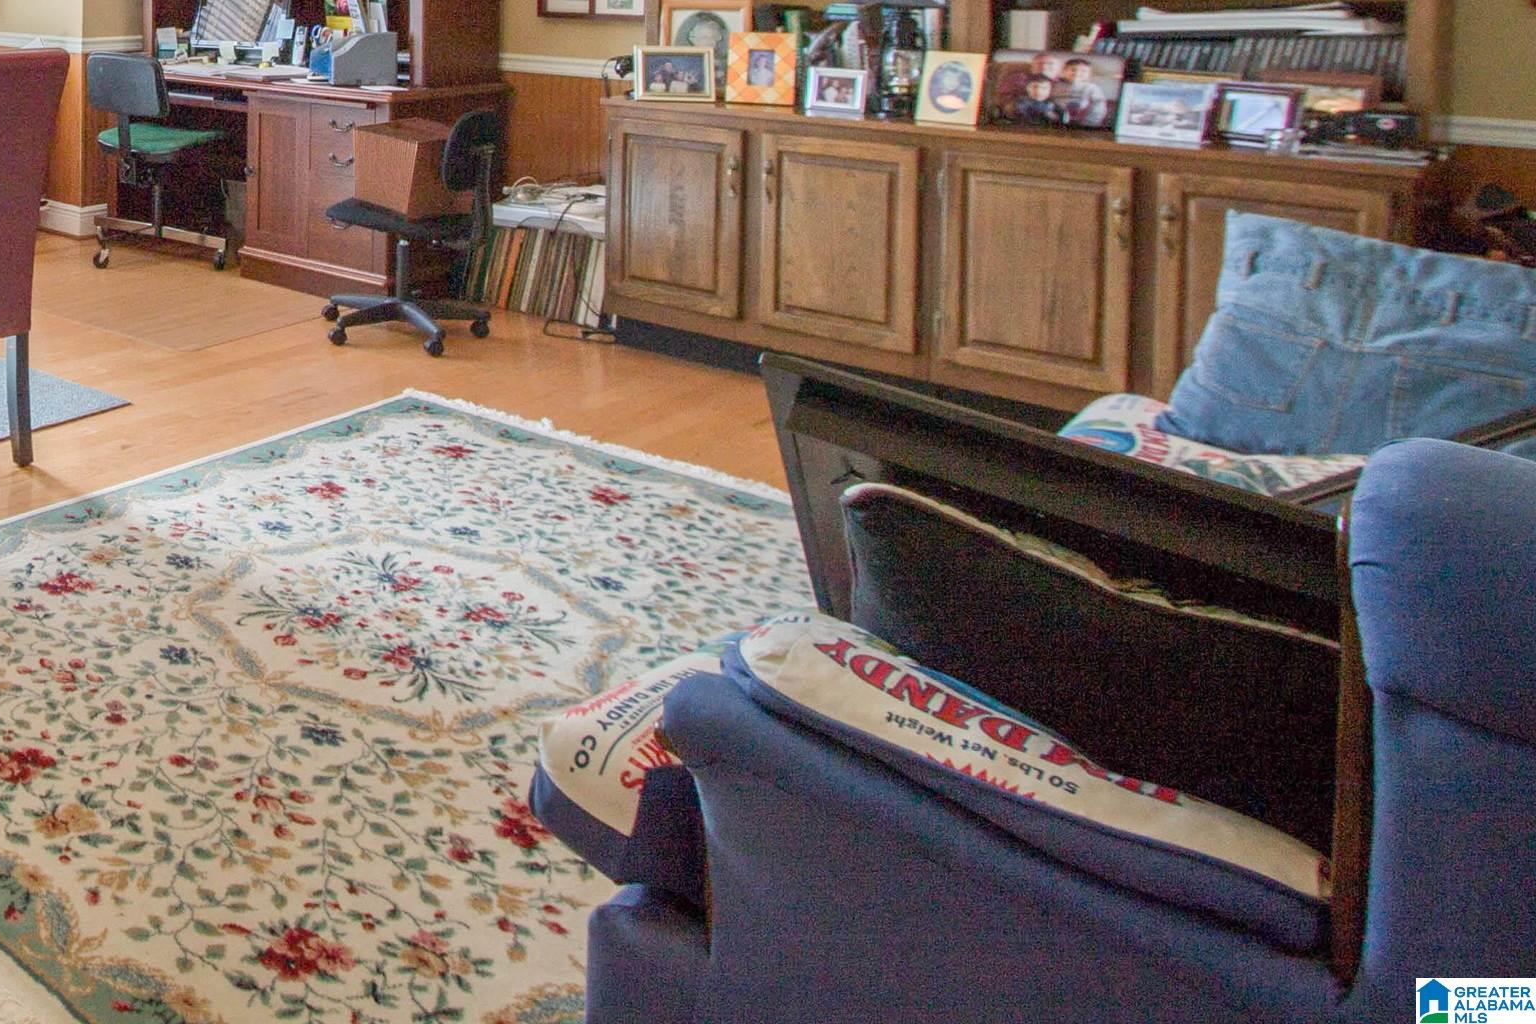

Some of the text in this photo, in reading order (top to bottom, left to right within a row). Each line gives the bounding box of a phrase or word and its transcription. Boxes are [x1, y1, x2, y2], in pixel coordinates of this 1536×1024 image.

[645, 678, 672, 695] JIM
[813, 636, 1040, 754] DANDY
[596, 690, 650, 733] DANDY
[568, 733, 598, 774] CO.
[884, 710, 1081, 796] 50 Lbs. Net Weight
